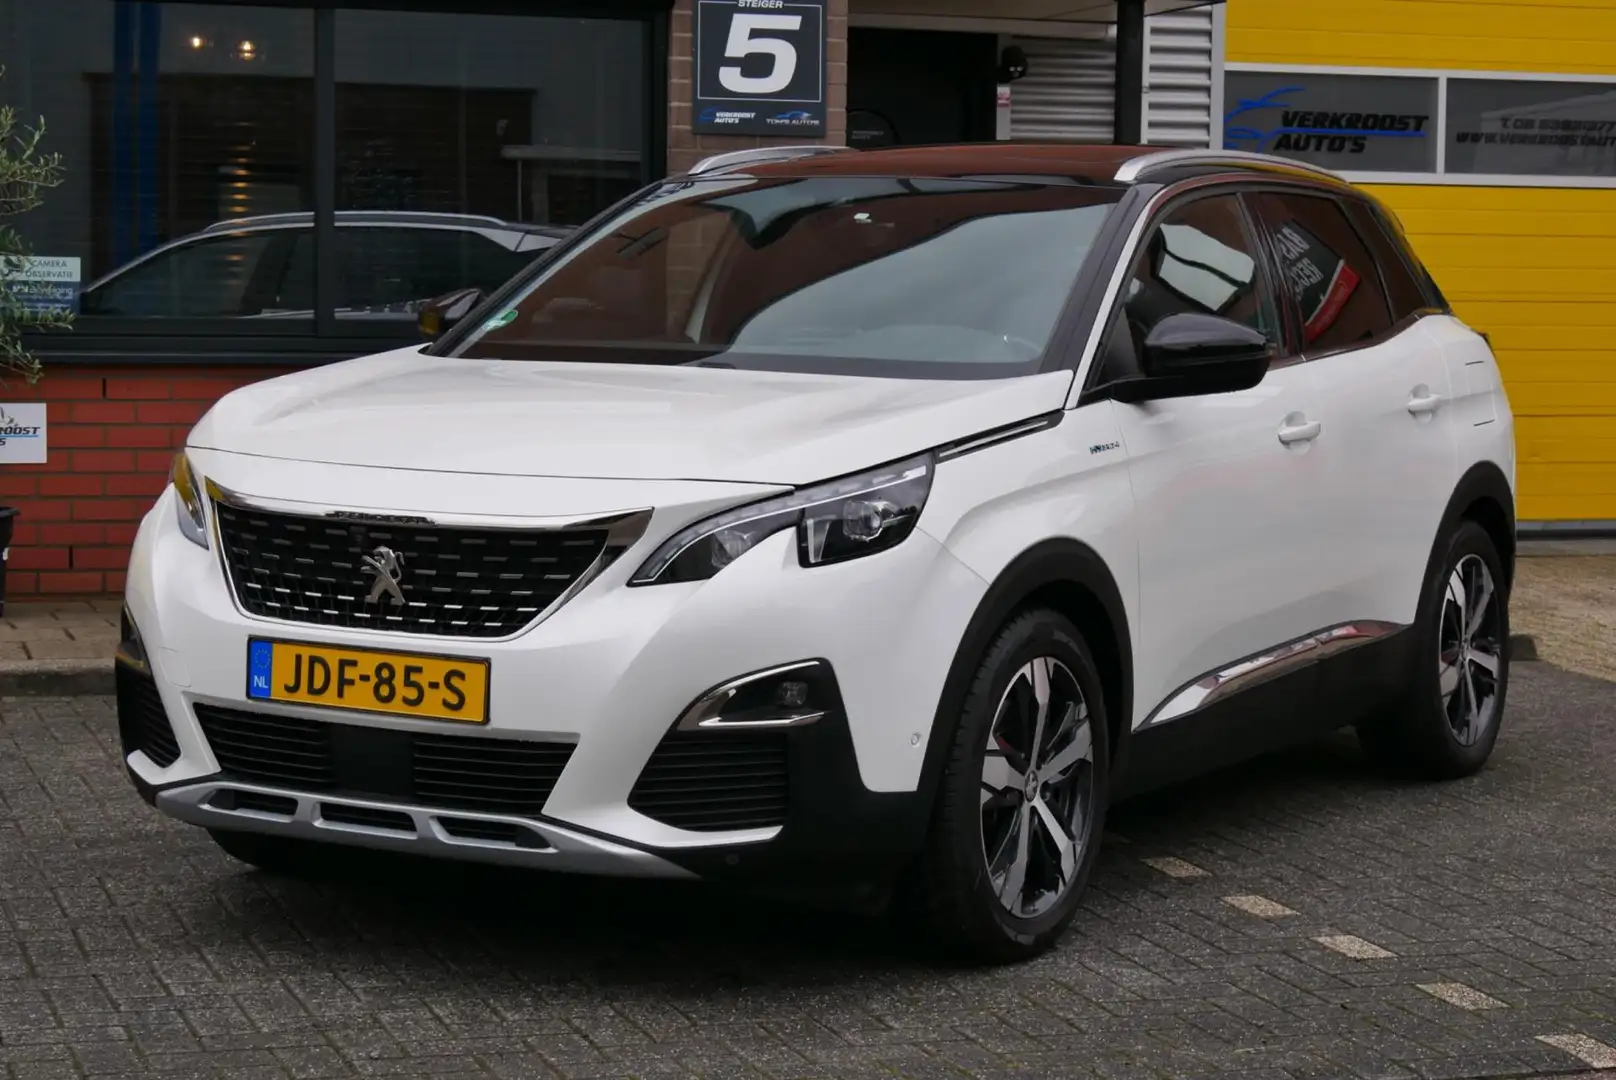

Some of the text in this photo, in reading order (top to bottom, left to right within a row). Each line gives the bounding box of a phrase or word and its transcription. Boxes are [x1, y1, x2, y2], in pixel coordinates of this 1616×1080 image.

[738, 0, 783, 8] STEIGER
[718, 13, 802, 93] 5
[1281, 110, 1429, 132] VERKROOST
[1273, 135, 1367, 153] AUTO'S
[31, 259, 68, 268] CAMERA
[25, 270, 73, 279] OBSERVATIE
[253, 675, 269, 689] NL
[284, 654, 467, 711] JDF-85-S
